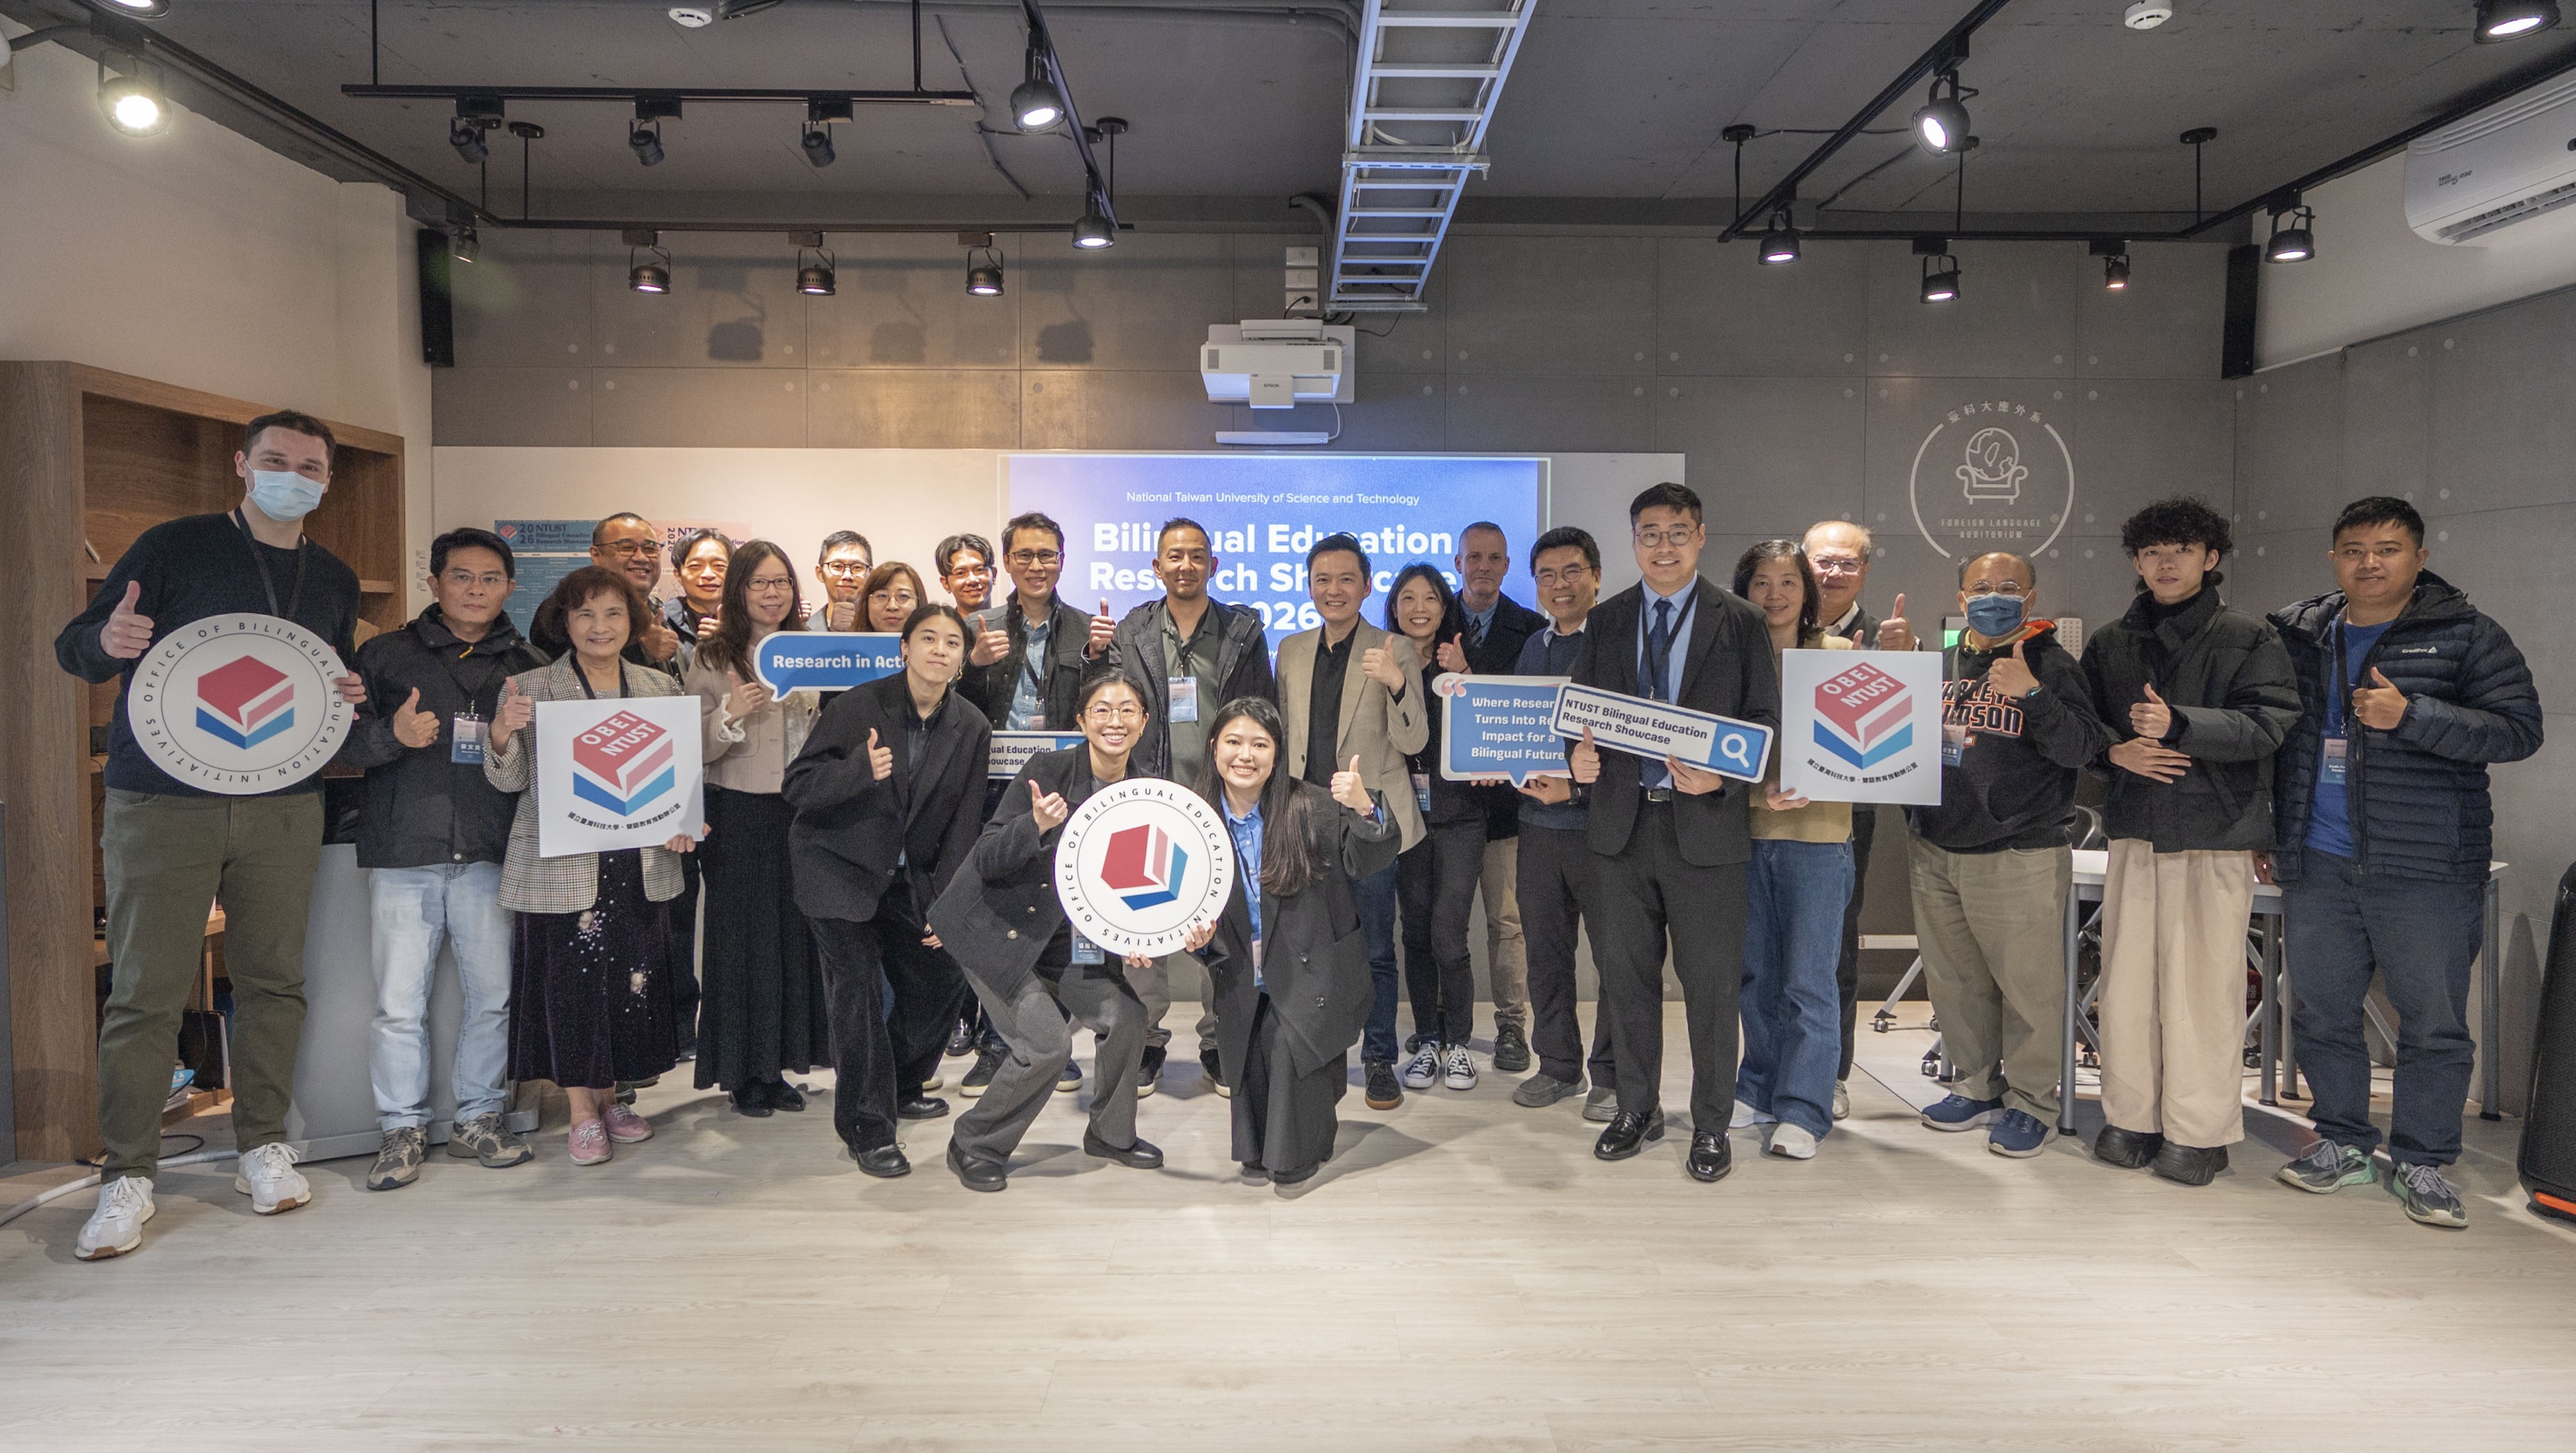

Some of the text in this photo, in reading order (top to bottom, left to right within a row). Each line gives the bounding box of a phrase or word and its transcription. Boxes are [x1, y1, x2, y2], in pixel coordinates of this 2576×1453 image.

[1947, 400, 2042, 423] 臺科大應外系
[1126, 492, 1419, 506] National Taiwan University of Science and Technology
[520, 524, 534, 533] 20
[1942, 518, 2042, 527] FOREIGN LANGUAGE
[520, 534, 534, 544] 26
[1960, 531, 2022, 539] AUDITORIUM
[1228, 602, 1322, 631] 026
[773, 654, 851, 668] Research
[856, 654, 870, 668] in
[1822, 665, 1877, 695] OBEI
[1840, 676, 1895, 708] NTUST
[144, 622, 343, 783] OFFICE OF BILINGUAL EDUCATION INITIATIVES
[1472, 697, 1510, 708] Where
[1475, 714, 1509, 725] Turns
[1512, 715, 1536, 725] Into
[1565, 699, 1707, 739] NTUST Bilingual Education
[580, 713, 638, 745] OBEI
[1563, 712, 1671, 745] Research Showcase
[600, 723, 656, 756] NTUST
[1482, 731, 1555, 743] Impact for a
[1007, 745, 1051, 754] Education
[1471, 747, 1564, 761] Bilingual Future
[1065, 788, 1223, 946] OFFICE OF BILINGUAL EDUCATION INITIATIVES
